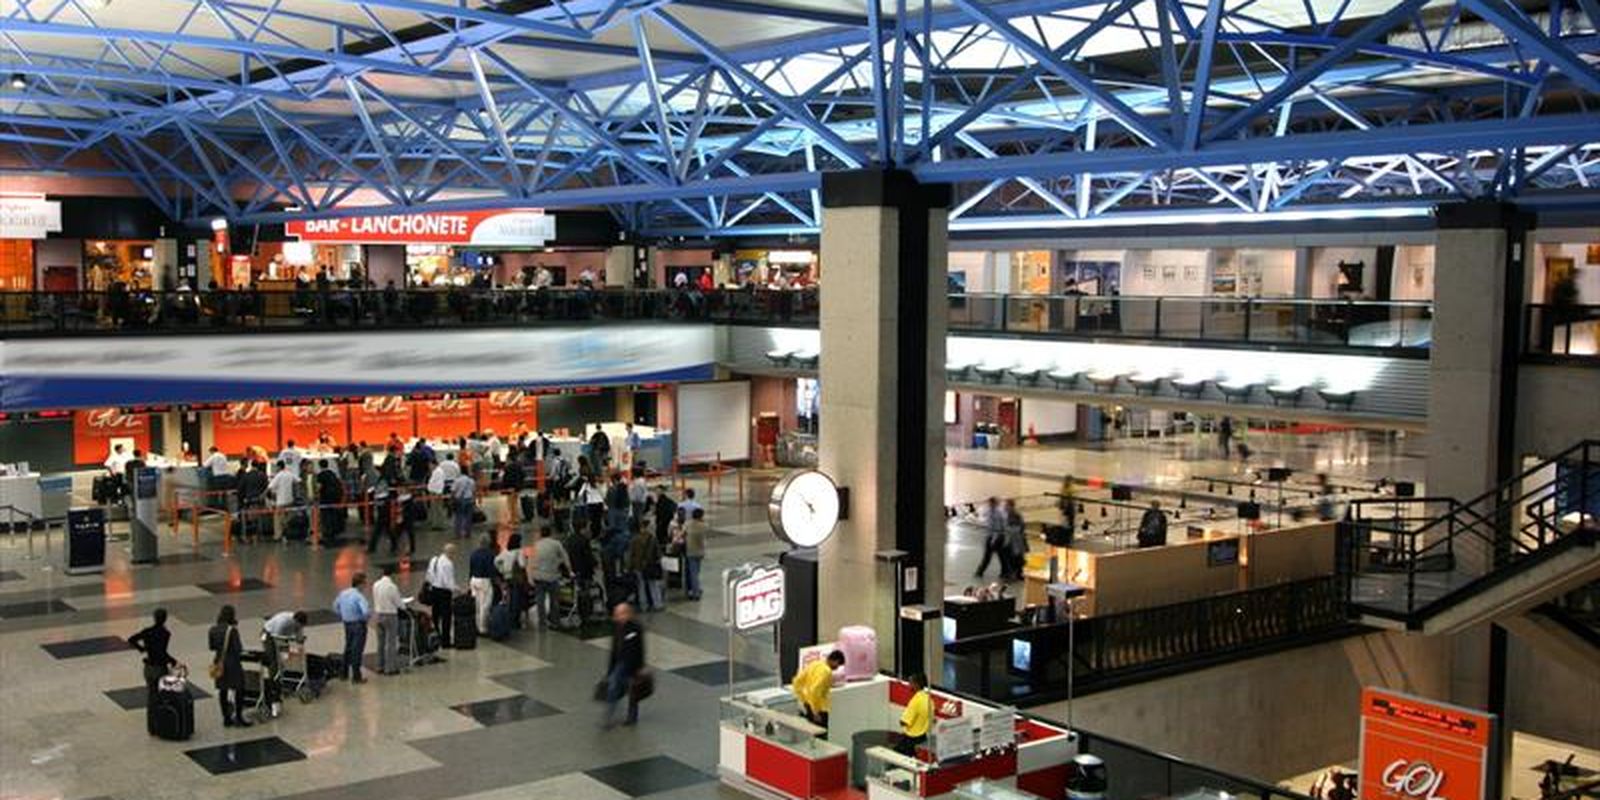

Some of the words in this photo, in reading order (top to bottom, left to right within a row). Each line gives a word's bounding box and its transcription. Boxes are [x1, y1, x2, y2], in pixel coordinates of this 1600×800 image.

[351, 216, 468, 235] LANCHONETE
[738, 592, 782, 624] BAG
[1382, 759, 1447, 800] GOL
